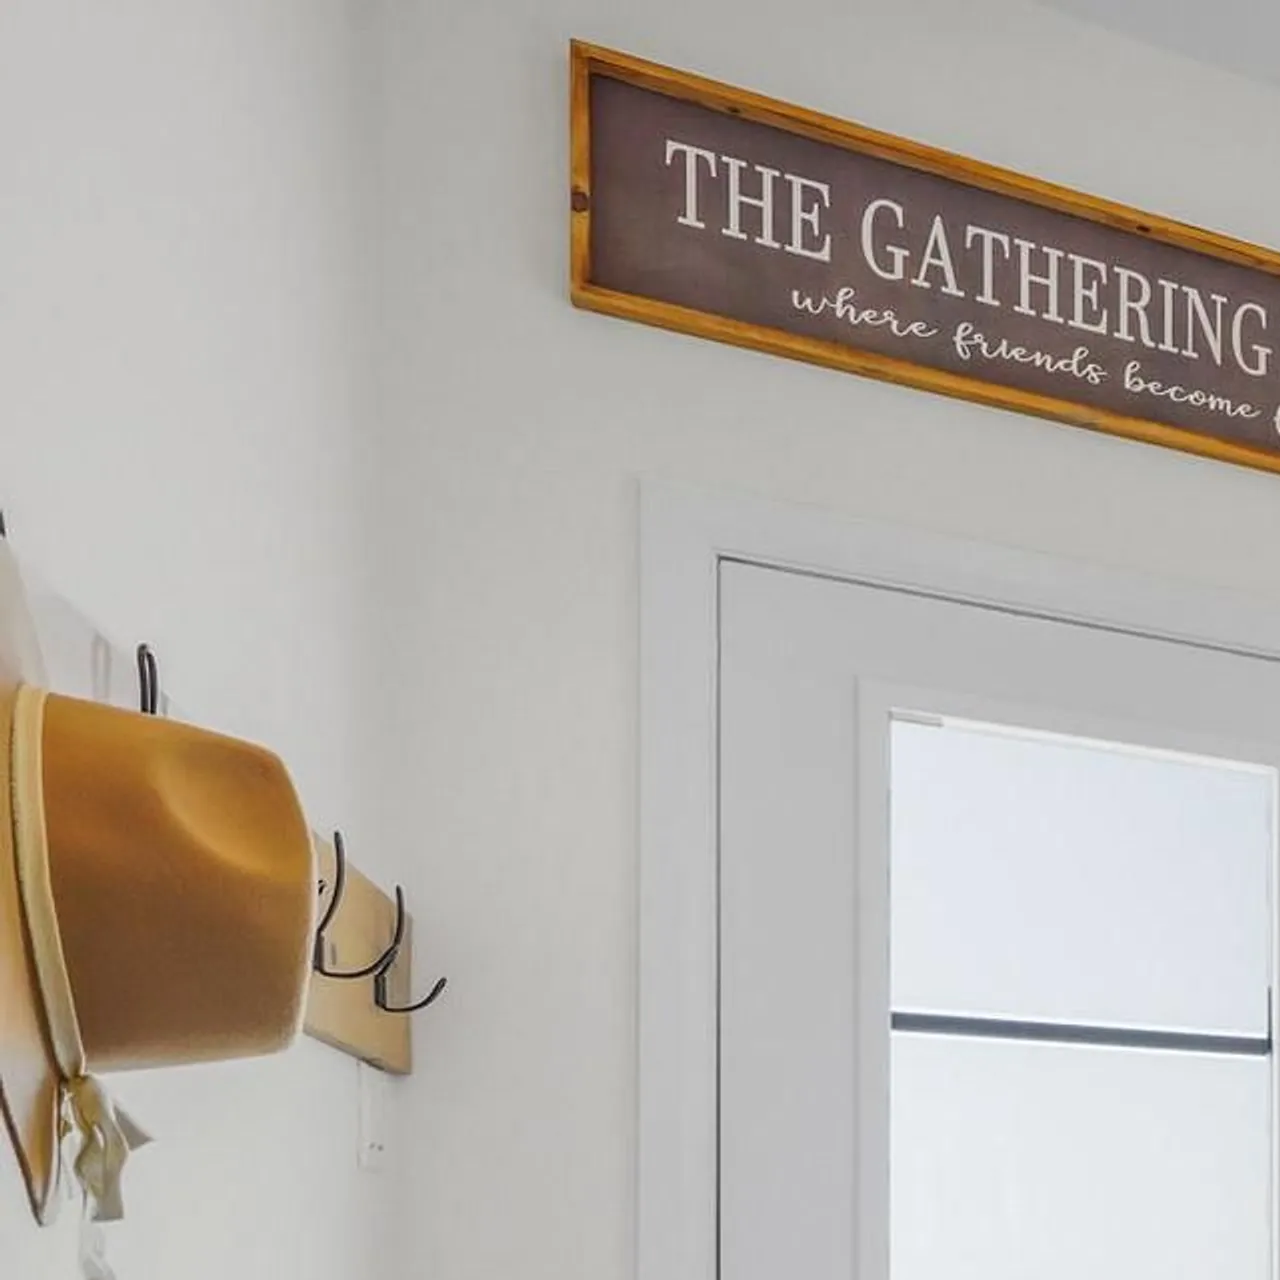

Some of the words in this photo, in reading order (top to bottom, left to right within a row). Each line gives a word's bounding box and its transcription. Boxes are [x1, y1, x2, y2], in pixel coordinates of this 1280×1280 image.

[665, 139, 832, 263] THE
[860, 198, 1273, 377] GATHERING
[791, 286, 939, 339] where
[952, 321, 1107, 386] friends
[1123, 360, 1262, 419] become
